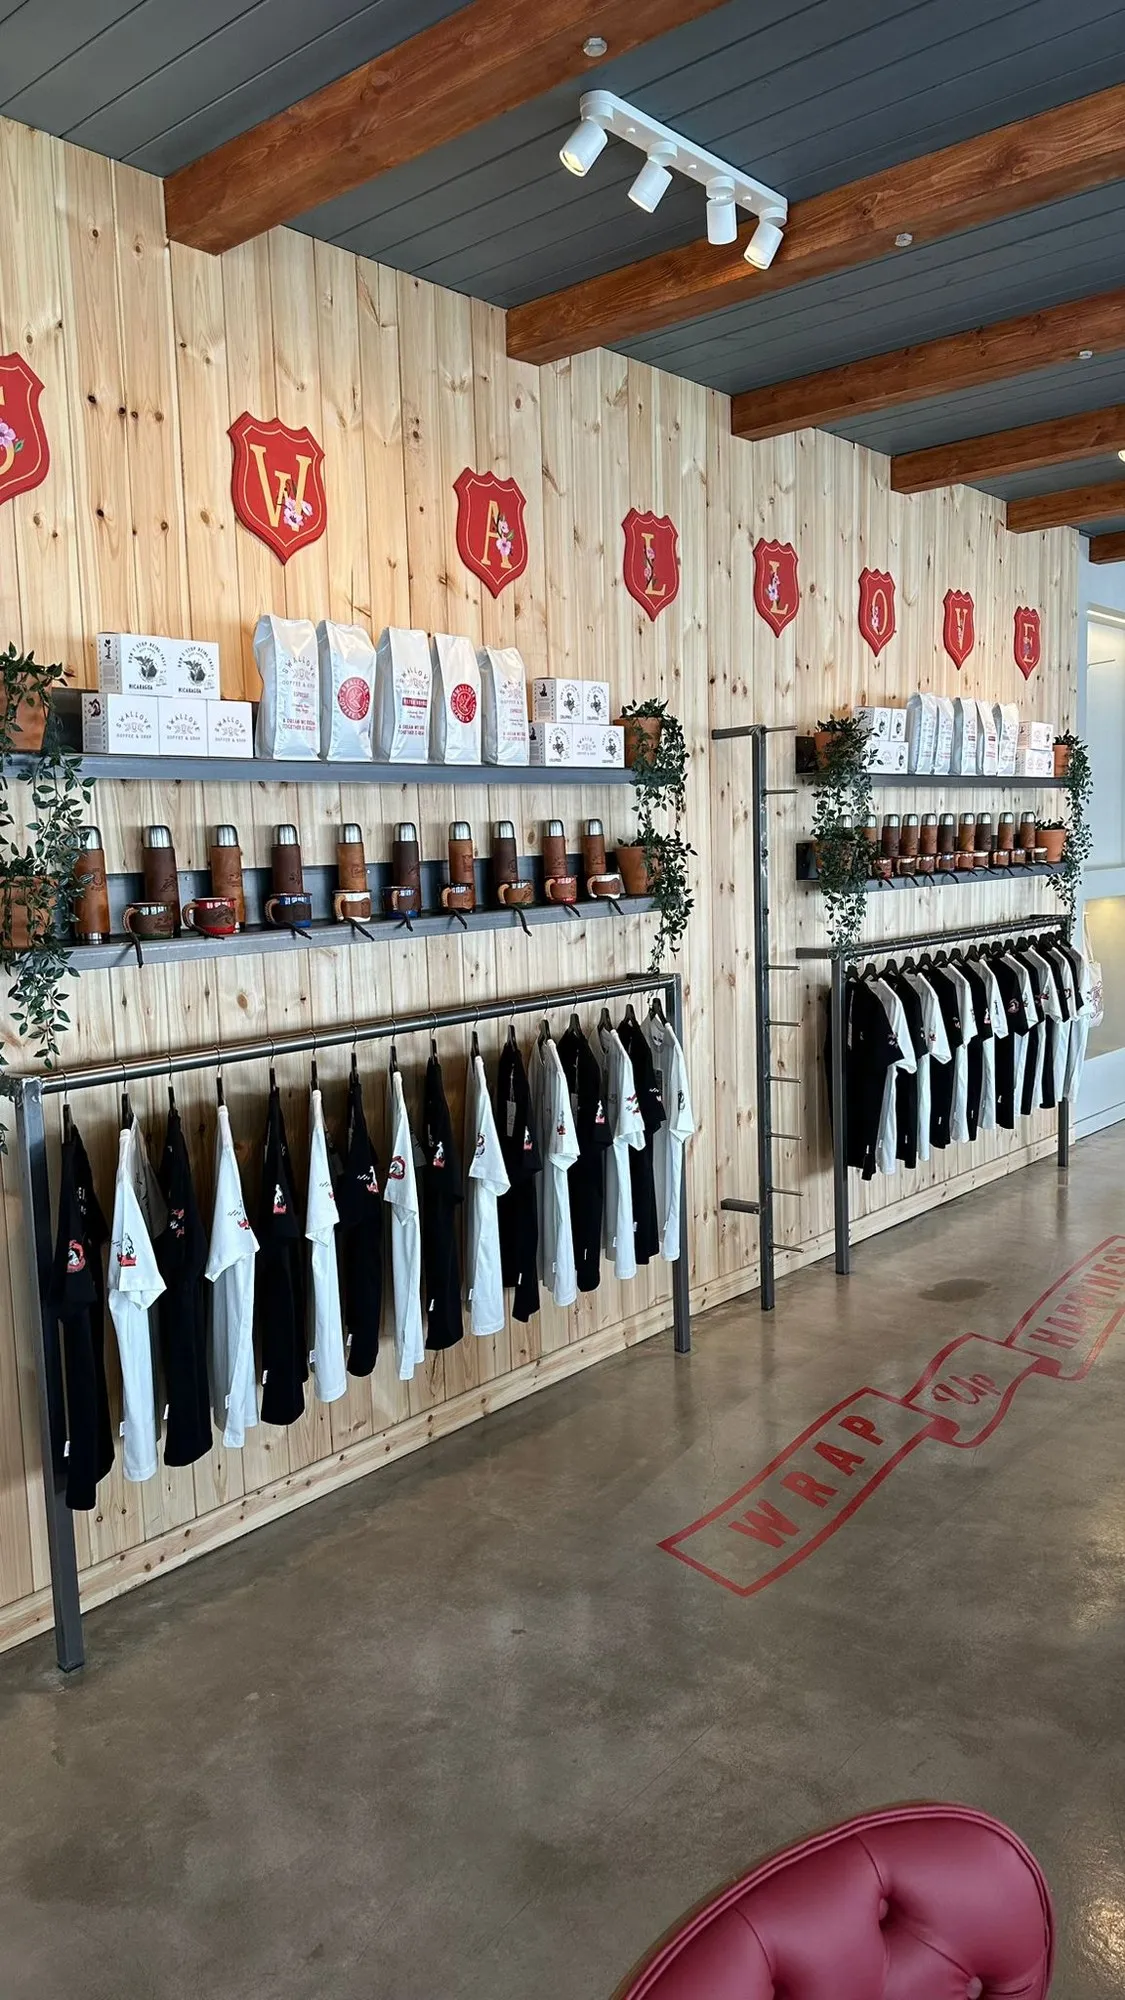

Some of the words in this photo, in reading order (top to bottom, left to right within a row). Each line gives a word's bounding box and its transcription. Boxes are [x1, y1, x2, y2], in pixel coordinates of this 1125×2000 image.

[250, 443, 312, 533] W
[481, 500, 513, 569] A
[641, 532, 666, 596] L
[769, 560, 788, 615] L
[871, 589, 888, 636] O
[955, 608, 968, 650] V
[116, 711, 150, 729] SWALLOVE
[166, 713, 200, 731] SWALLOVE
[214, 716, 246, 733] SWALLOVE
[1028, 1246, 1125, 1350] HAPPINES
[931, 1374, 1001, 1405] Up
[728, 1415, 884, 1549] WRAP
